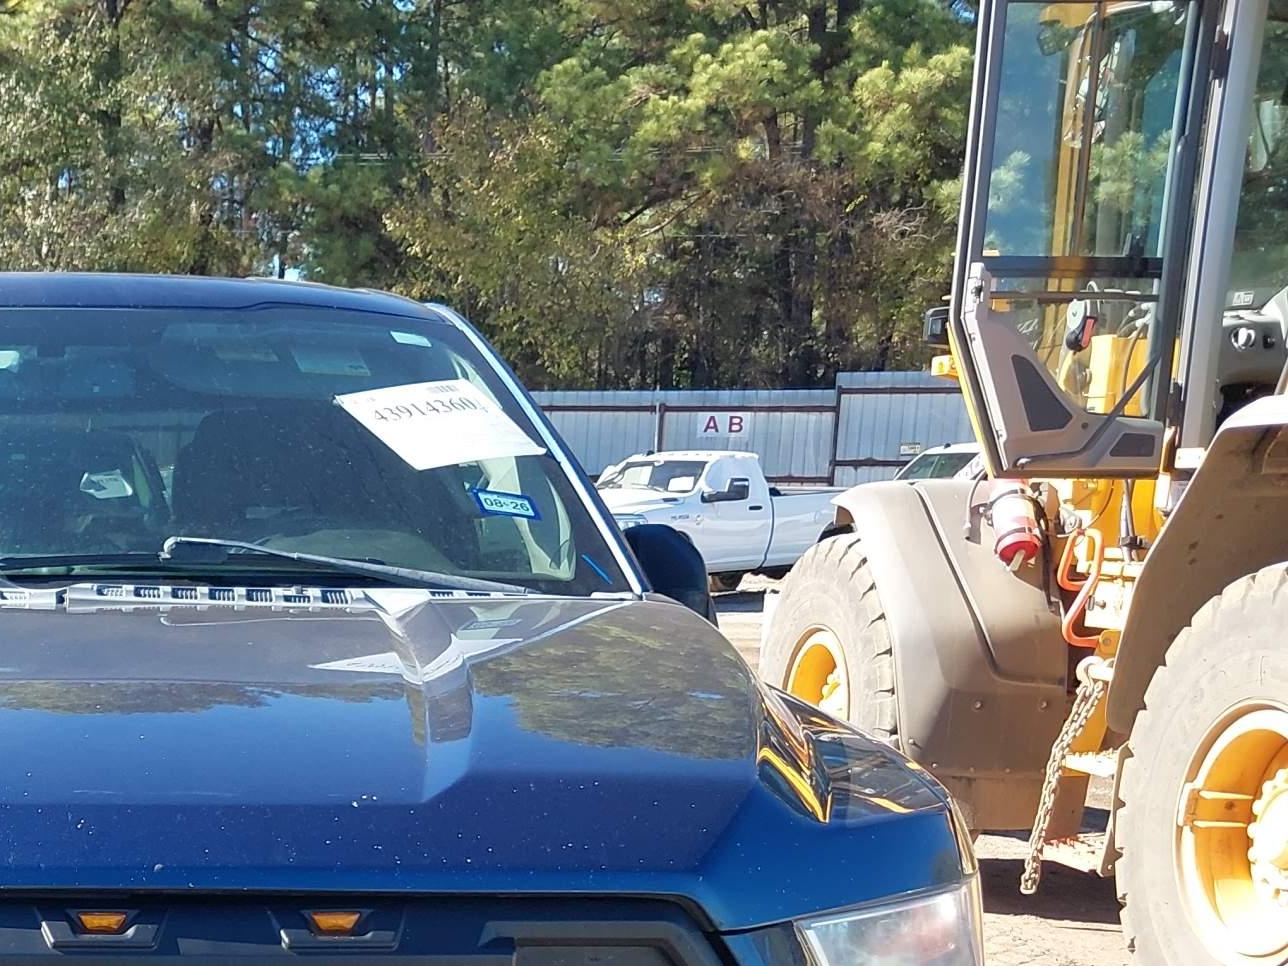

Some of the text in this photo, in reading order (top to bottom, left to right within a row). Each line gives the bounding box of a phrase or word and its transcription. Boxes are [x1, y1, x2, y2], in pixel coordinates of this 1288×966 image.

[373, 397, 478, 422] 43914360
[703, 415, 744, 433] A B
